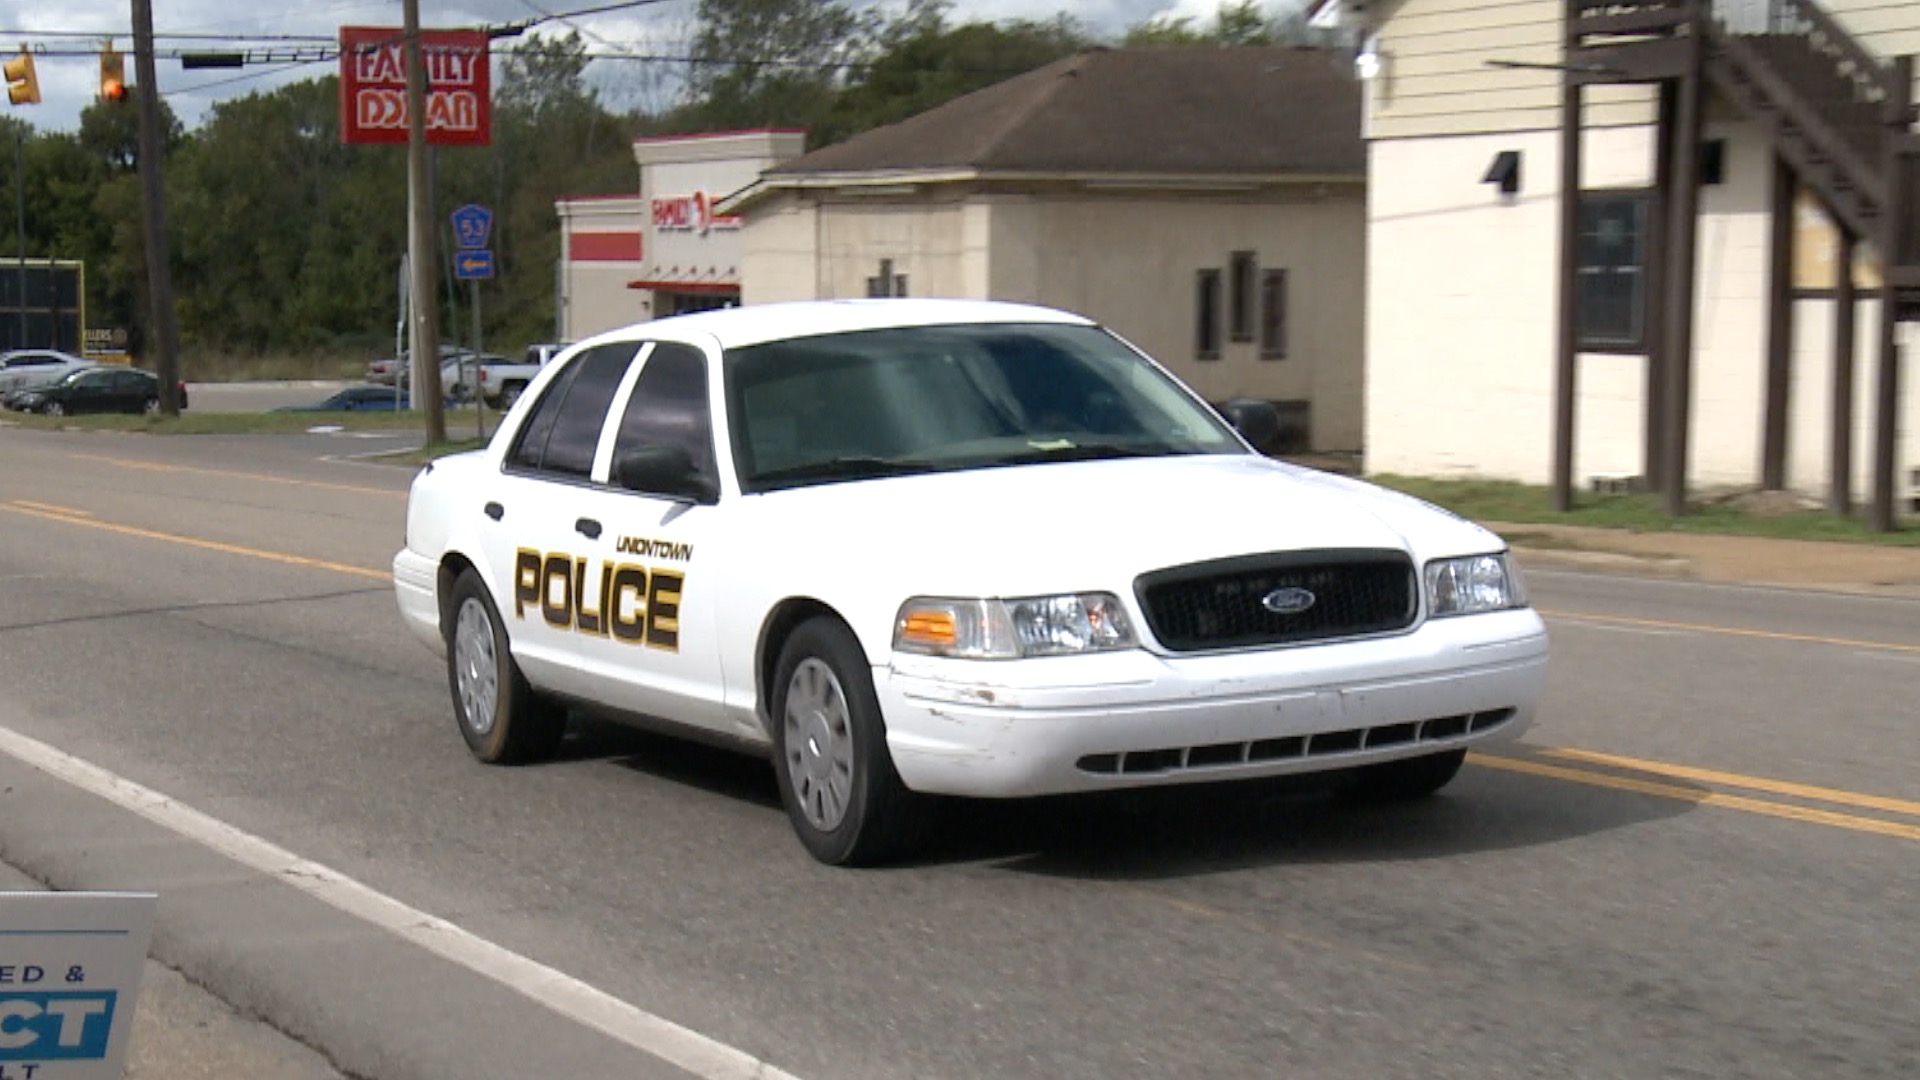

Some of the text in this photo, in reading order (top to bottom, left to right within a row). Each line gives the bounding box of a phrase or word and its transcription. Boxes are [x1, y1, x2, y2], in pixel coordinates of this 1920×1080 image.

[355, 43, 482, 83] FAILY
[356, 88, 477, 131] DOAR
[461, 219, 485, 236] 53
[616, 535, 694, 562] UNIONTOWN
[515, 546, 686, 654] POLICE
[65, 965, 85, 983] &
